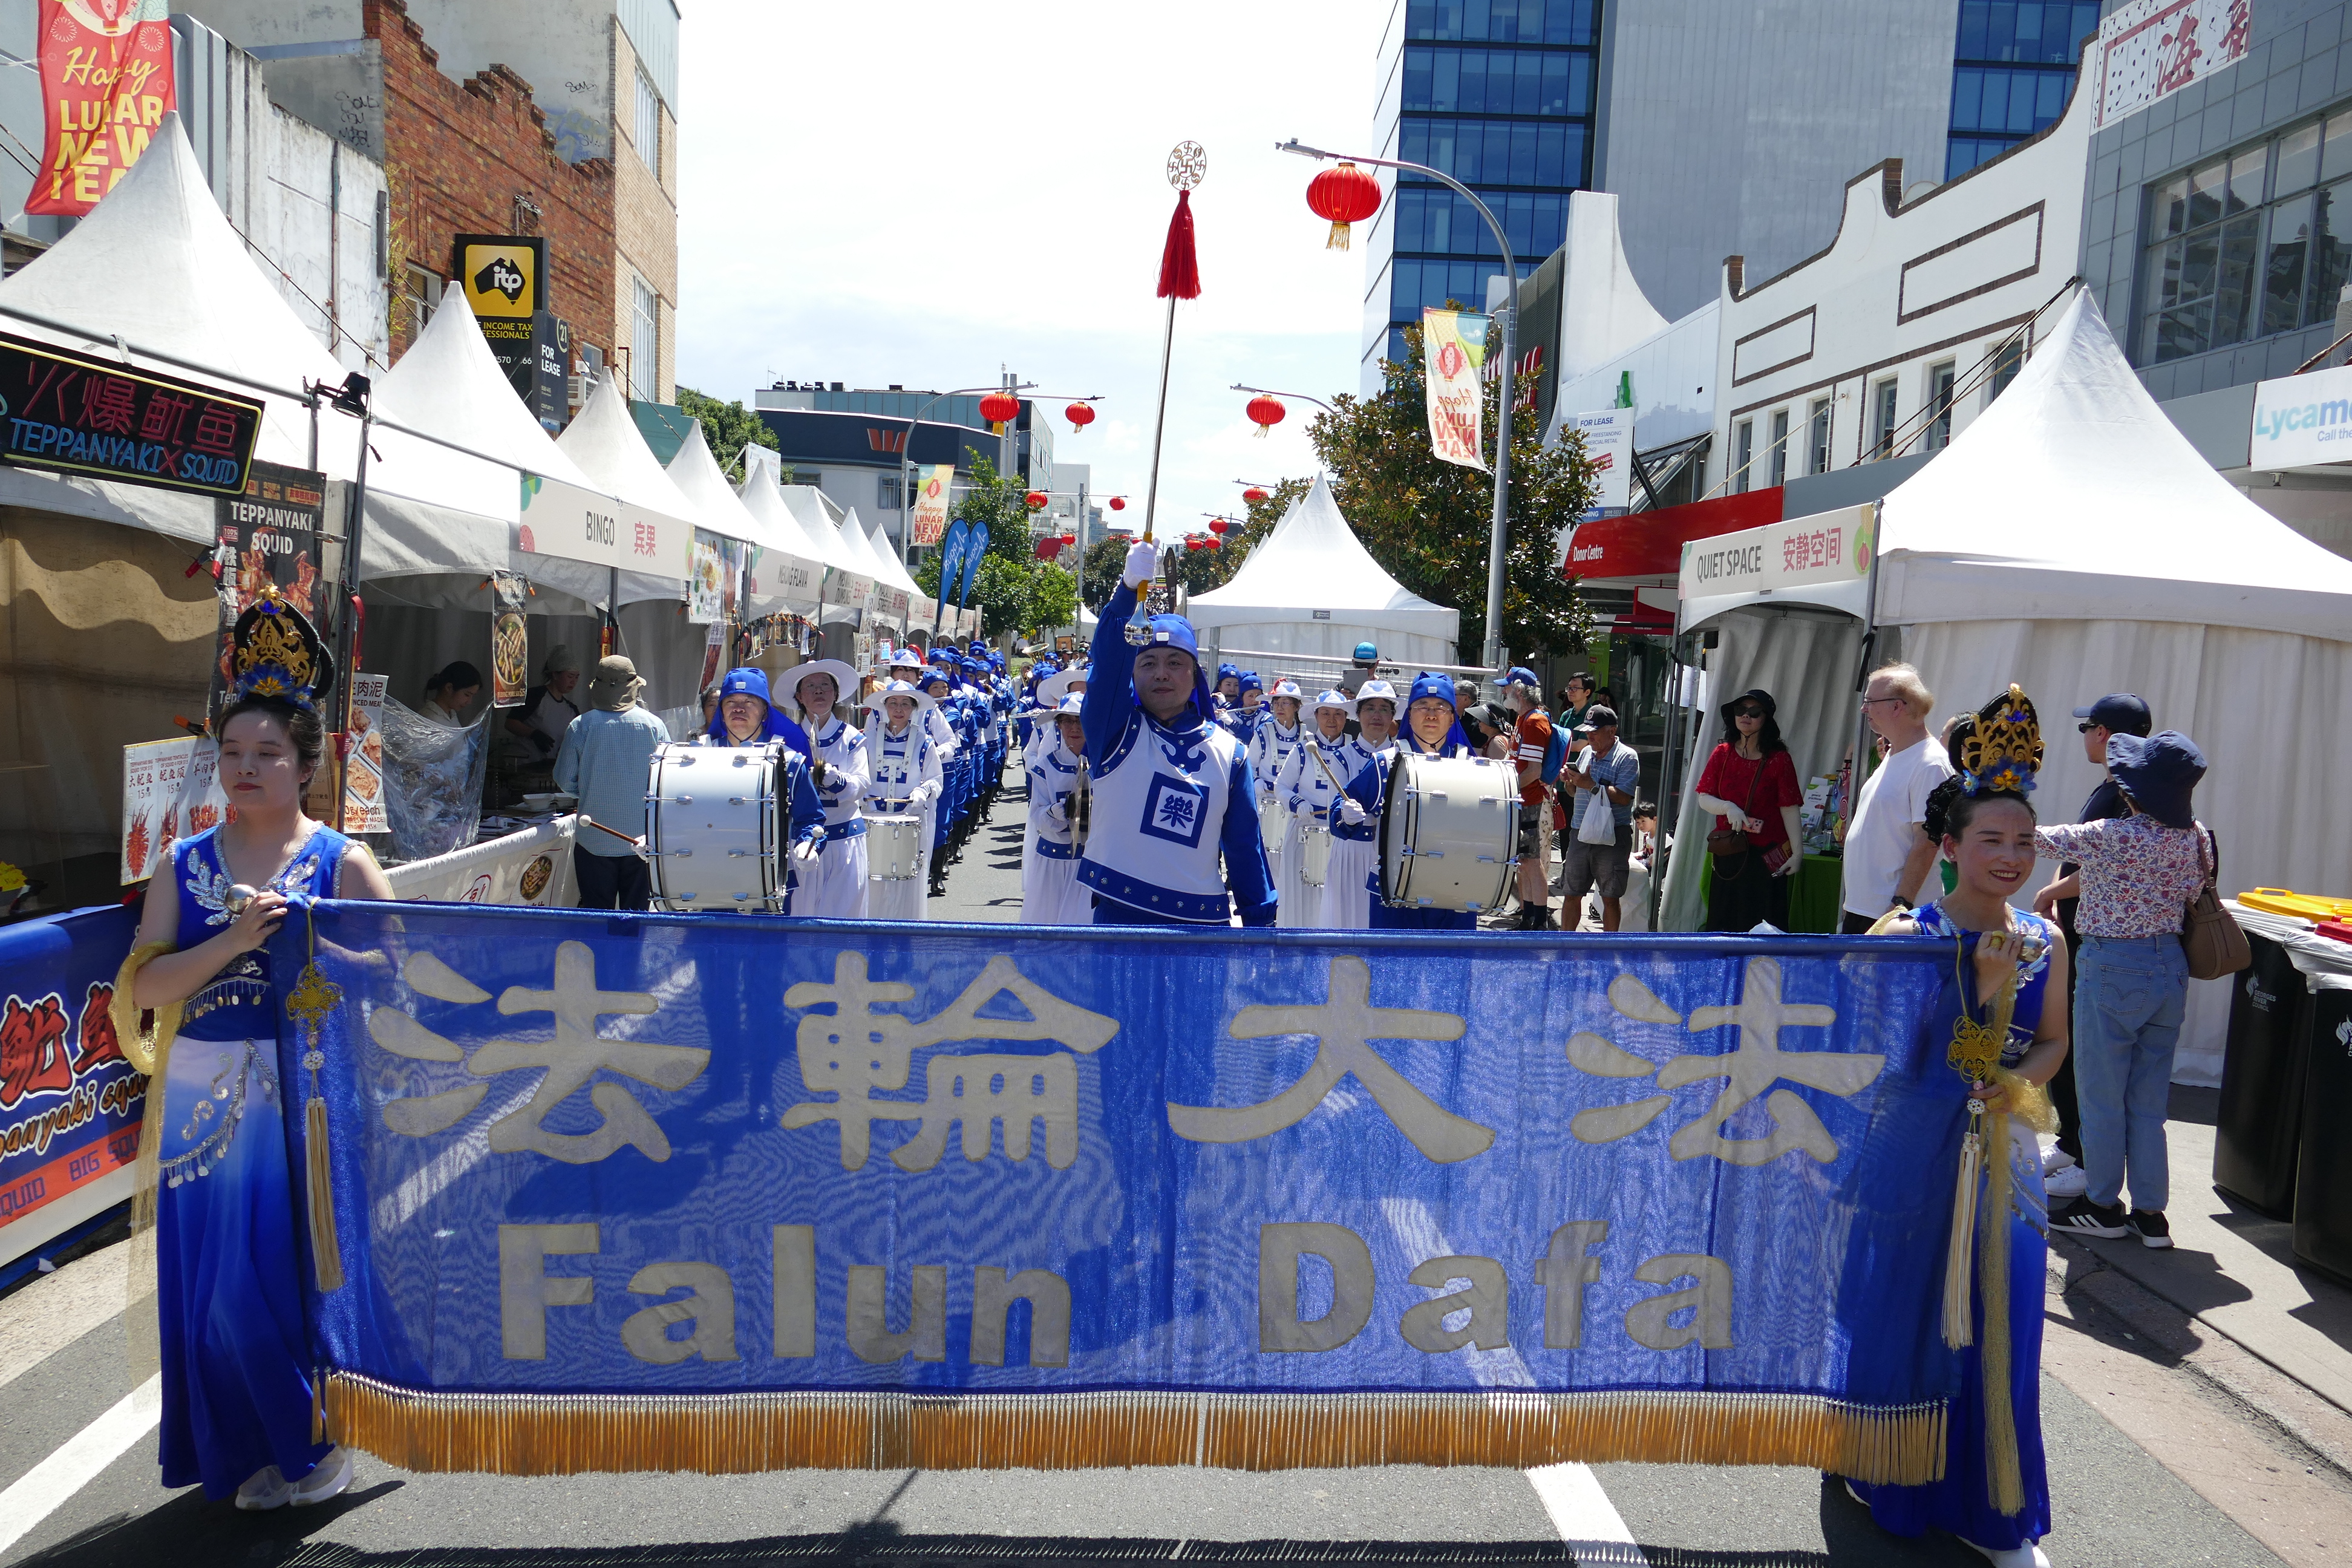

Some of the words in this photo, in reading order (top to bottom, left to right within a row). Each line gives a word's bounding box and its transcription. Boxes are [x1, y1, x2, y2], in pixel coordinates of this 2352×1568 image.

[493, 266, 521, 293] itp
[484, 322, 515, 330] INCOME
[541, 344, 554, 360] FOR
[541, 359, 561, 377] LEASE
[1580, 419, 1593, 427] FOR
[1593, 417, 1614, 425] LEASE
[1591, 430, 1622, 439] FREESTANDING
[2317, 428, 2337, 442] Call
[10, 417, 164, 474] TEPPANYAKI
[179, 452, 240, 485] SQUID
[917, 501, 943, 515] Happy
[230, 501, 313, 532] TEPPANYAKI
[915, 515, 943, 524] LUNAR
[586, 511, 615, 546] BINGO
[915, 523, 942, 534] NEW
[251, 531, 293, 557] SQUID
[634, 521, 656, 558] 宾果
[914, 534, 941, 543] YEAR
[943, 541, 958, 572] Bupa
[965, 541, 979, 569] Bupa
[1573, 546, 1587, 562] Donor
[1587, 544, 1604, 561] Centre
[1783, 527, 1842, 573] 安静空间
[1697, 552, 1725, 583] QUIET
[1726, 544, 1762, 577] SPACE
[193, 761, 216, 776] 羊肉串
[129, 773, 153, 788] 大鱿鱼
[200, 778, 207, 788] 15
[137, 789, 145, 799] 15
[168, 784, 174, 794] 15
[1160, 794, 1194, 829] 樂
[2253, 995, 2267, 1005] RIVER
[2254, 990, 2276, 1002] GEORGES
[2252, 1001, 2270, 1012] COUNCIL
[368, 939, 1886, 1172] 法輪大法
[0, 1177, 47, 1217] QUID
[69, 1151, 100, 1183] BIG
[498, 1222, 1072, 1369] Falun
[1258, 1219, 1734, 1353] Dafa
